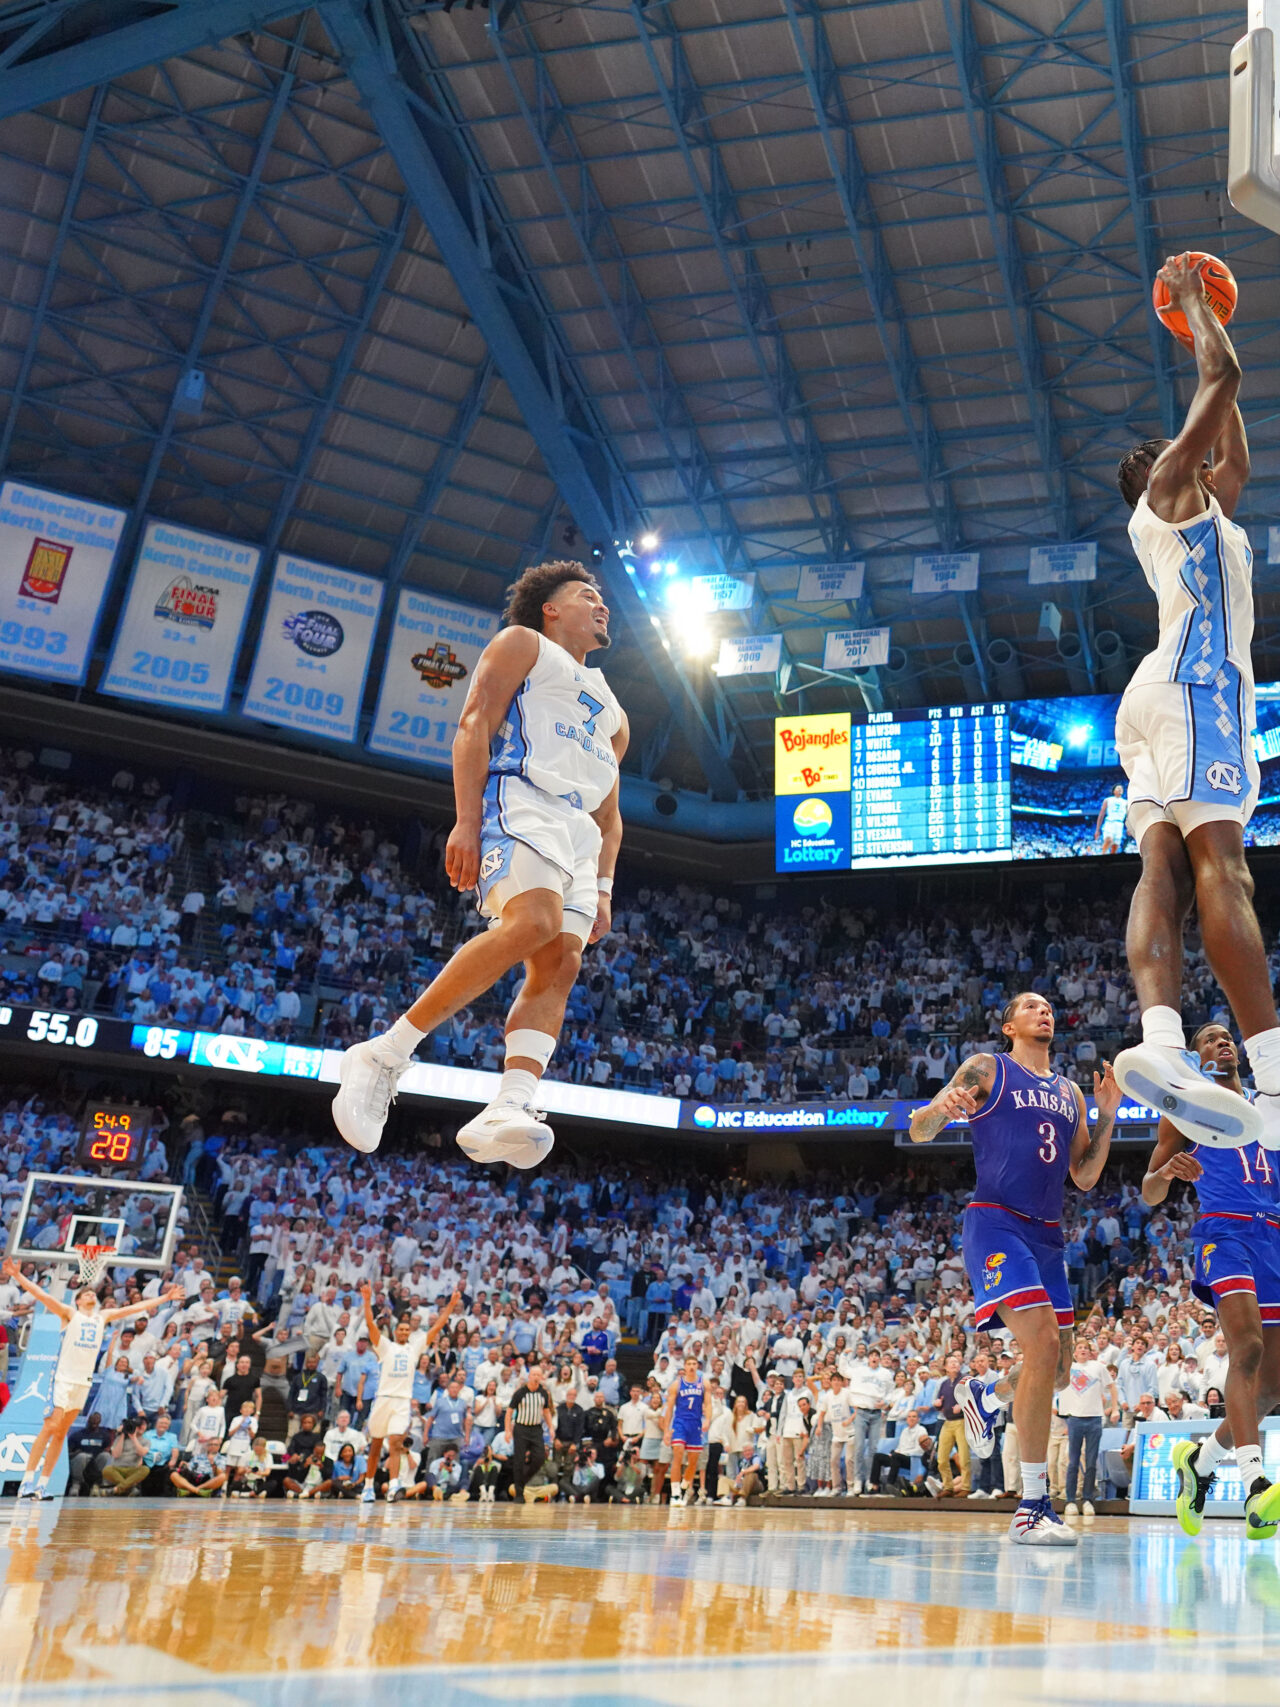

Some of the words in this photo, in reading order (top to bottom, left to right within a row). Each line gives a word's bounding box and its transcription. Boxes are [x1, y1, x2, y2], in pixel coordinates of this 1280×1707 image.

[171, 586, 217, 606] FINAL
[0, 618, 69, 655] 993
[293, 623, 337, 649] FOUR
[305, 619, 339, 636] FINAL
[846, 645, 868, 657] 2017
[130, 650, 210, 684] 2005
[263, 676, 344, 716] 2009
[578, 690, 605, 737] 7
[868, 712, 893, 724] PLAYER
[928, 708, 942, 719] PTS
[950, 706, 963, 717] REB
[970, 705, 984, 716] AST
[992, 703, 1006, 715] FLS
[388, 711, 459, 743] 201
[780, 727, 848, 752] Bojangles
[929, 733, 942, 747] 10
[791, 840, 802, 848] NC
[803, 838, 836, 848] Education
[784, 848, 842, 864] Lottery
[27, 1010, 99, 1048] 55.0
[143, 1027, 179, 1060] 85
[1011, 1089, 1075, 1124] KANSAS
[94, 1112, 131, 1131] 54.9
[717, 1111, 742, 1128] NC
[743, 1110, 825, 1127] Education
[826, 1109, 888, 1128] Lottery
[91, 1132, 132, 1161] 28
[1038, 1122, 1058, 1164] 3
[1235, 1147, 1273, 1185] 14
[80, 1329, 97, 1342] 13
[392, 1359, 408, 1372] 15
[687, 1397, 695, 1409] 7
